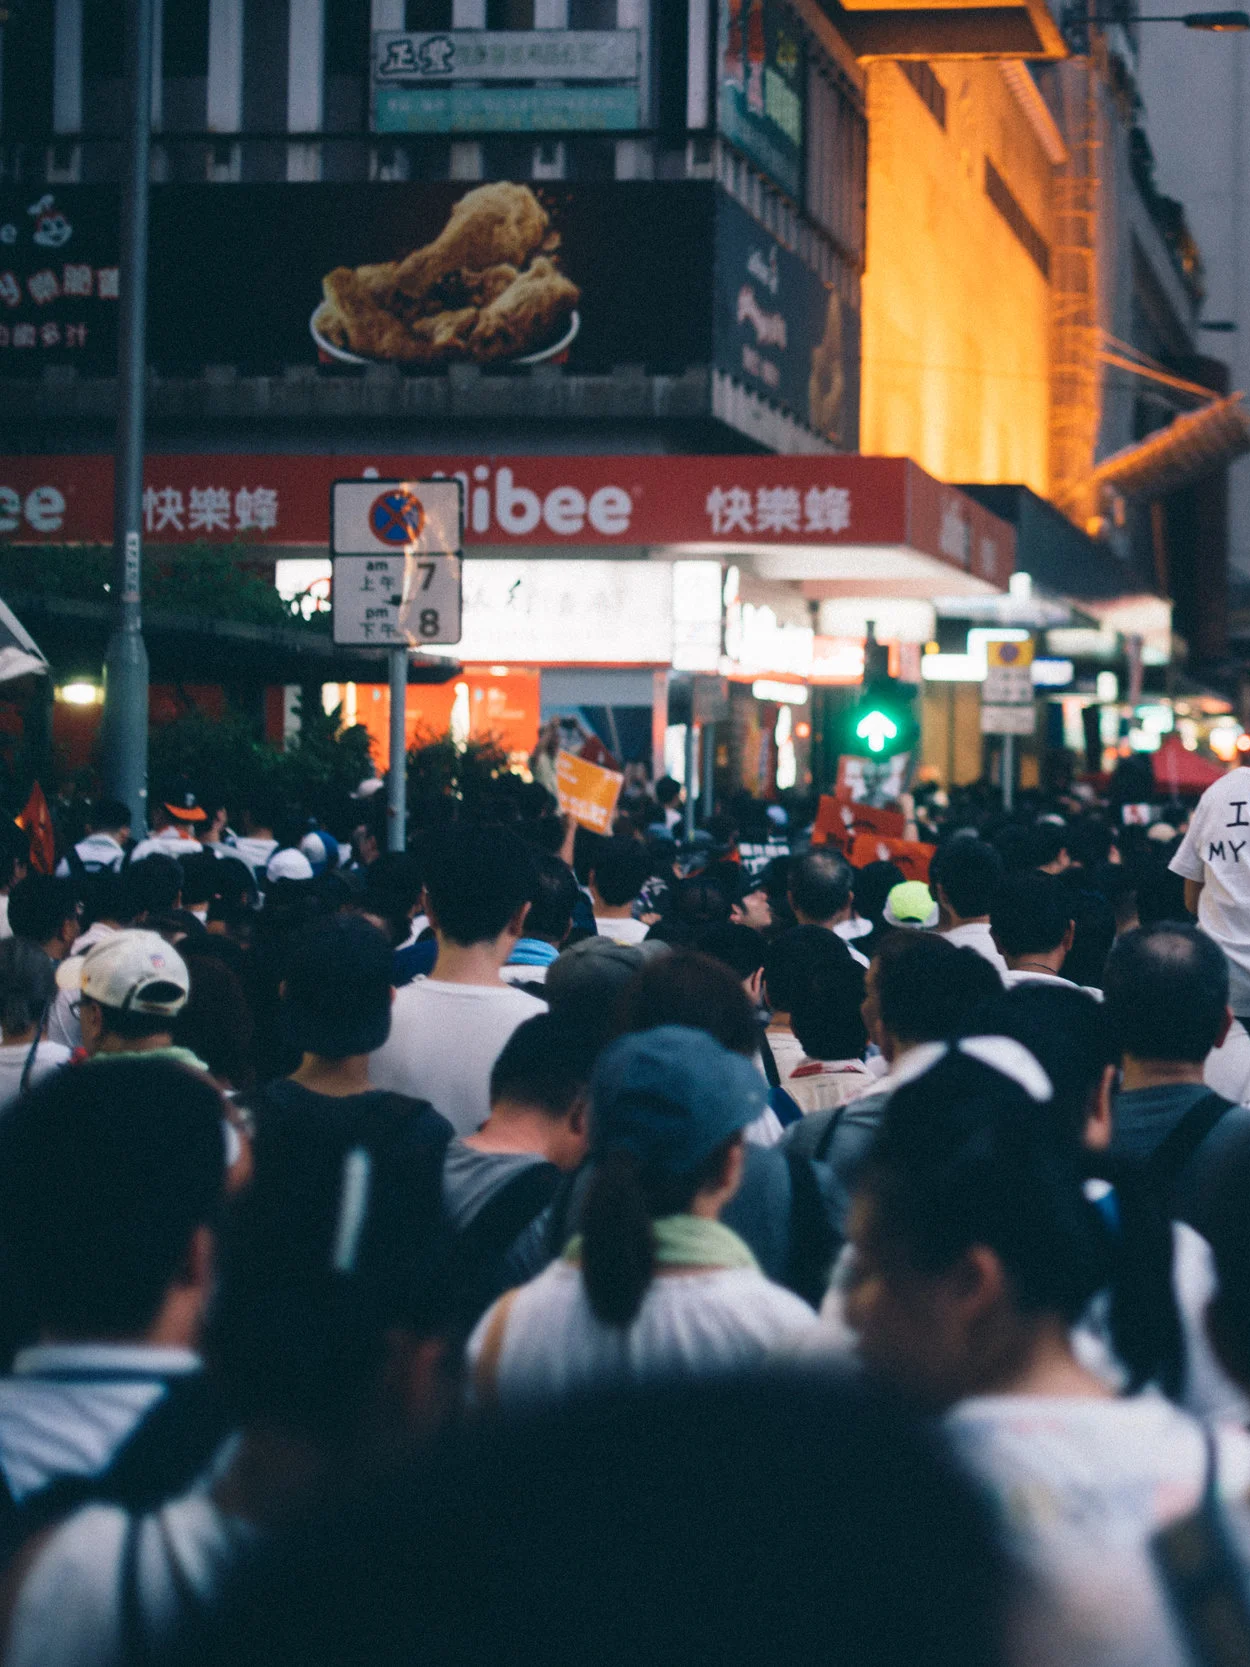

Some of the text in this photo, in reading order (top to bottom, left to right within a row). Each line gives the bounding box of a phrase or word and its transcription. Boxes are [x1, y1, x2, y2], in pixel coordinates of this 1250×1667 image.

[142, 484, 279, 532] 快樂蜂
[706, 484, 852, 534] 快樂蜂
[366, 561, 388, 571] am
[417, 563, 438, 591] 7
[359, 575, 394, 592] 上午
[366, 608, 389, 619] pm
[419, 608, 440, 638] 8
[359, 622, 395, 639] 下午
[1226, 800, 1249, 827] I
[1208, 840, 1247, 863] MY
